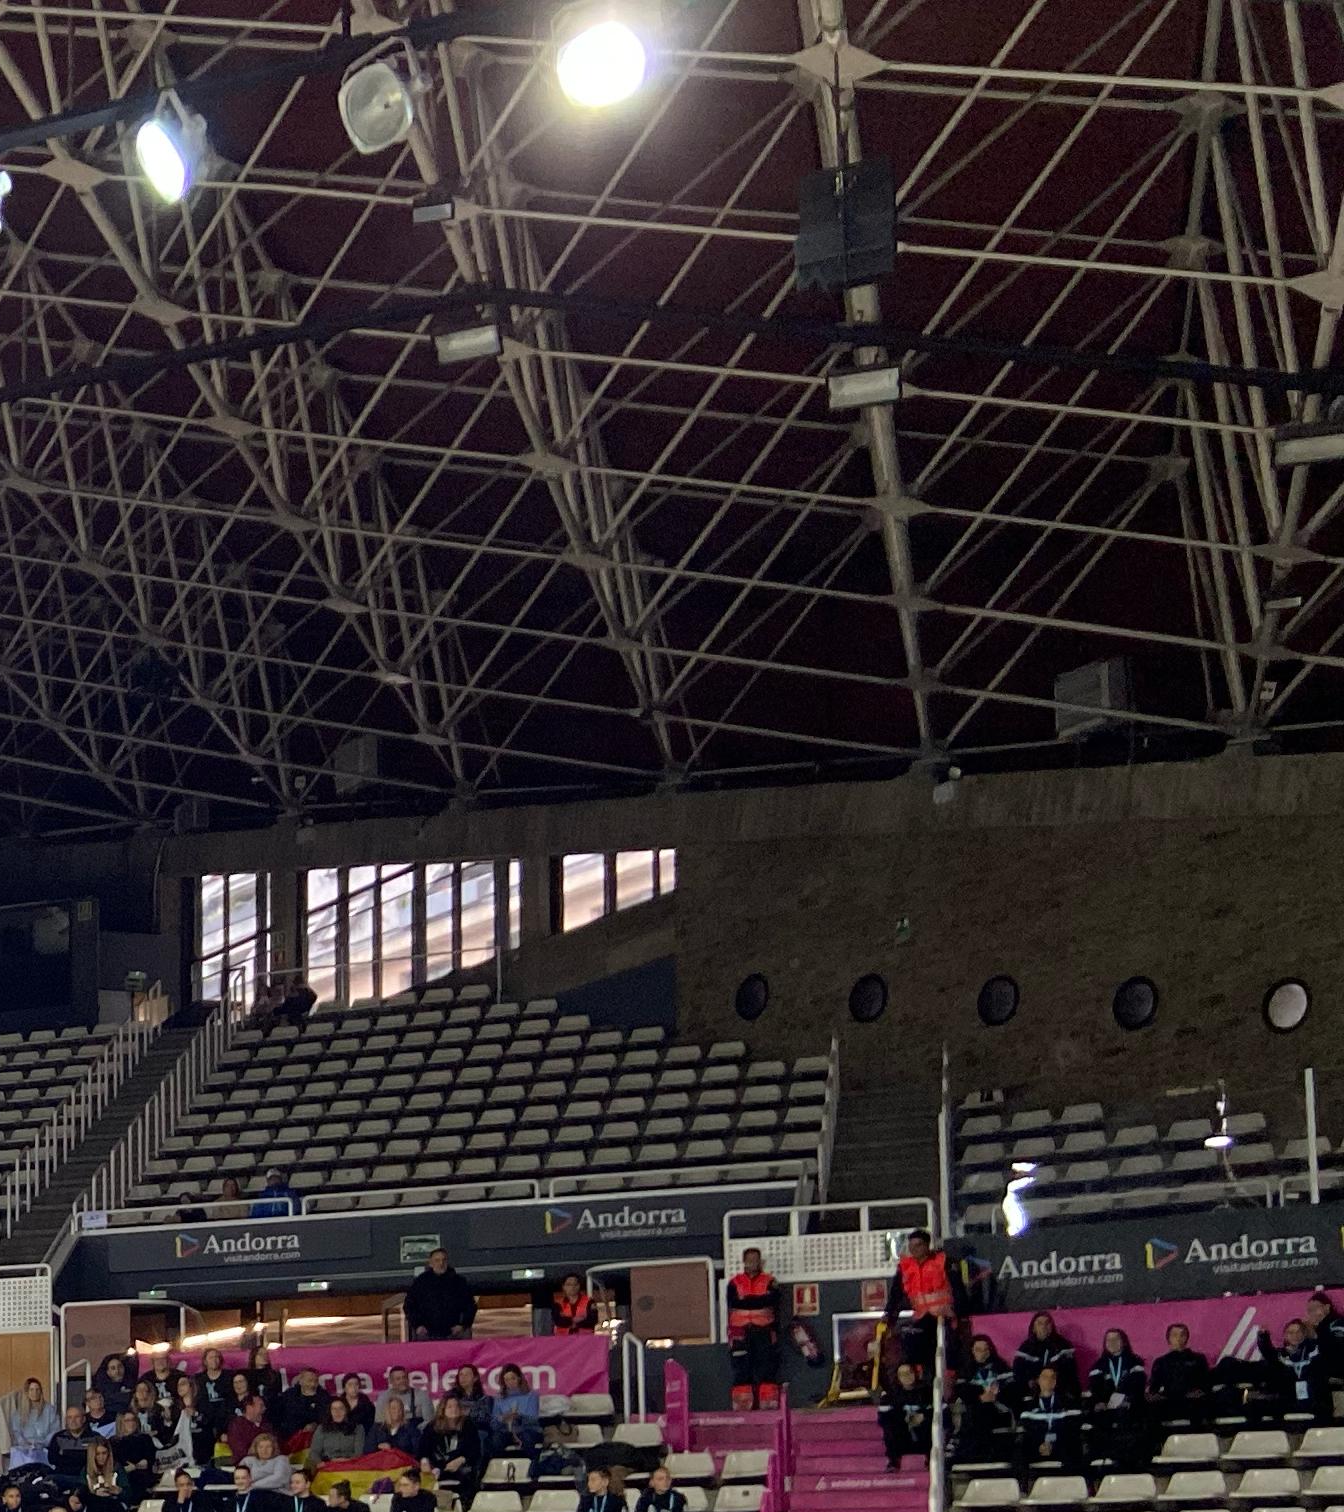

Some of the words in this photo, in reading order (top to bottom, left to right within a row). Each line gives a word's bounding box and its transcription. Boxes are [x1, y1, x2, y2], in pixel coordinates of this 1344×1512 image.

[577, 1204, 686, 1231] Andorra
[203, 1231, 300, 1254] Andorra
[223, 1248, 301, 1262] visitandorra.com
[1184, 1233, 1317, 1263] Andorra
[998, 1250, 1122, 1280] Andorra
[1212, 1256, 1318, 1274] visitandorra.com
